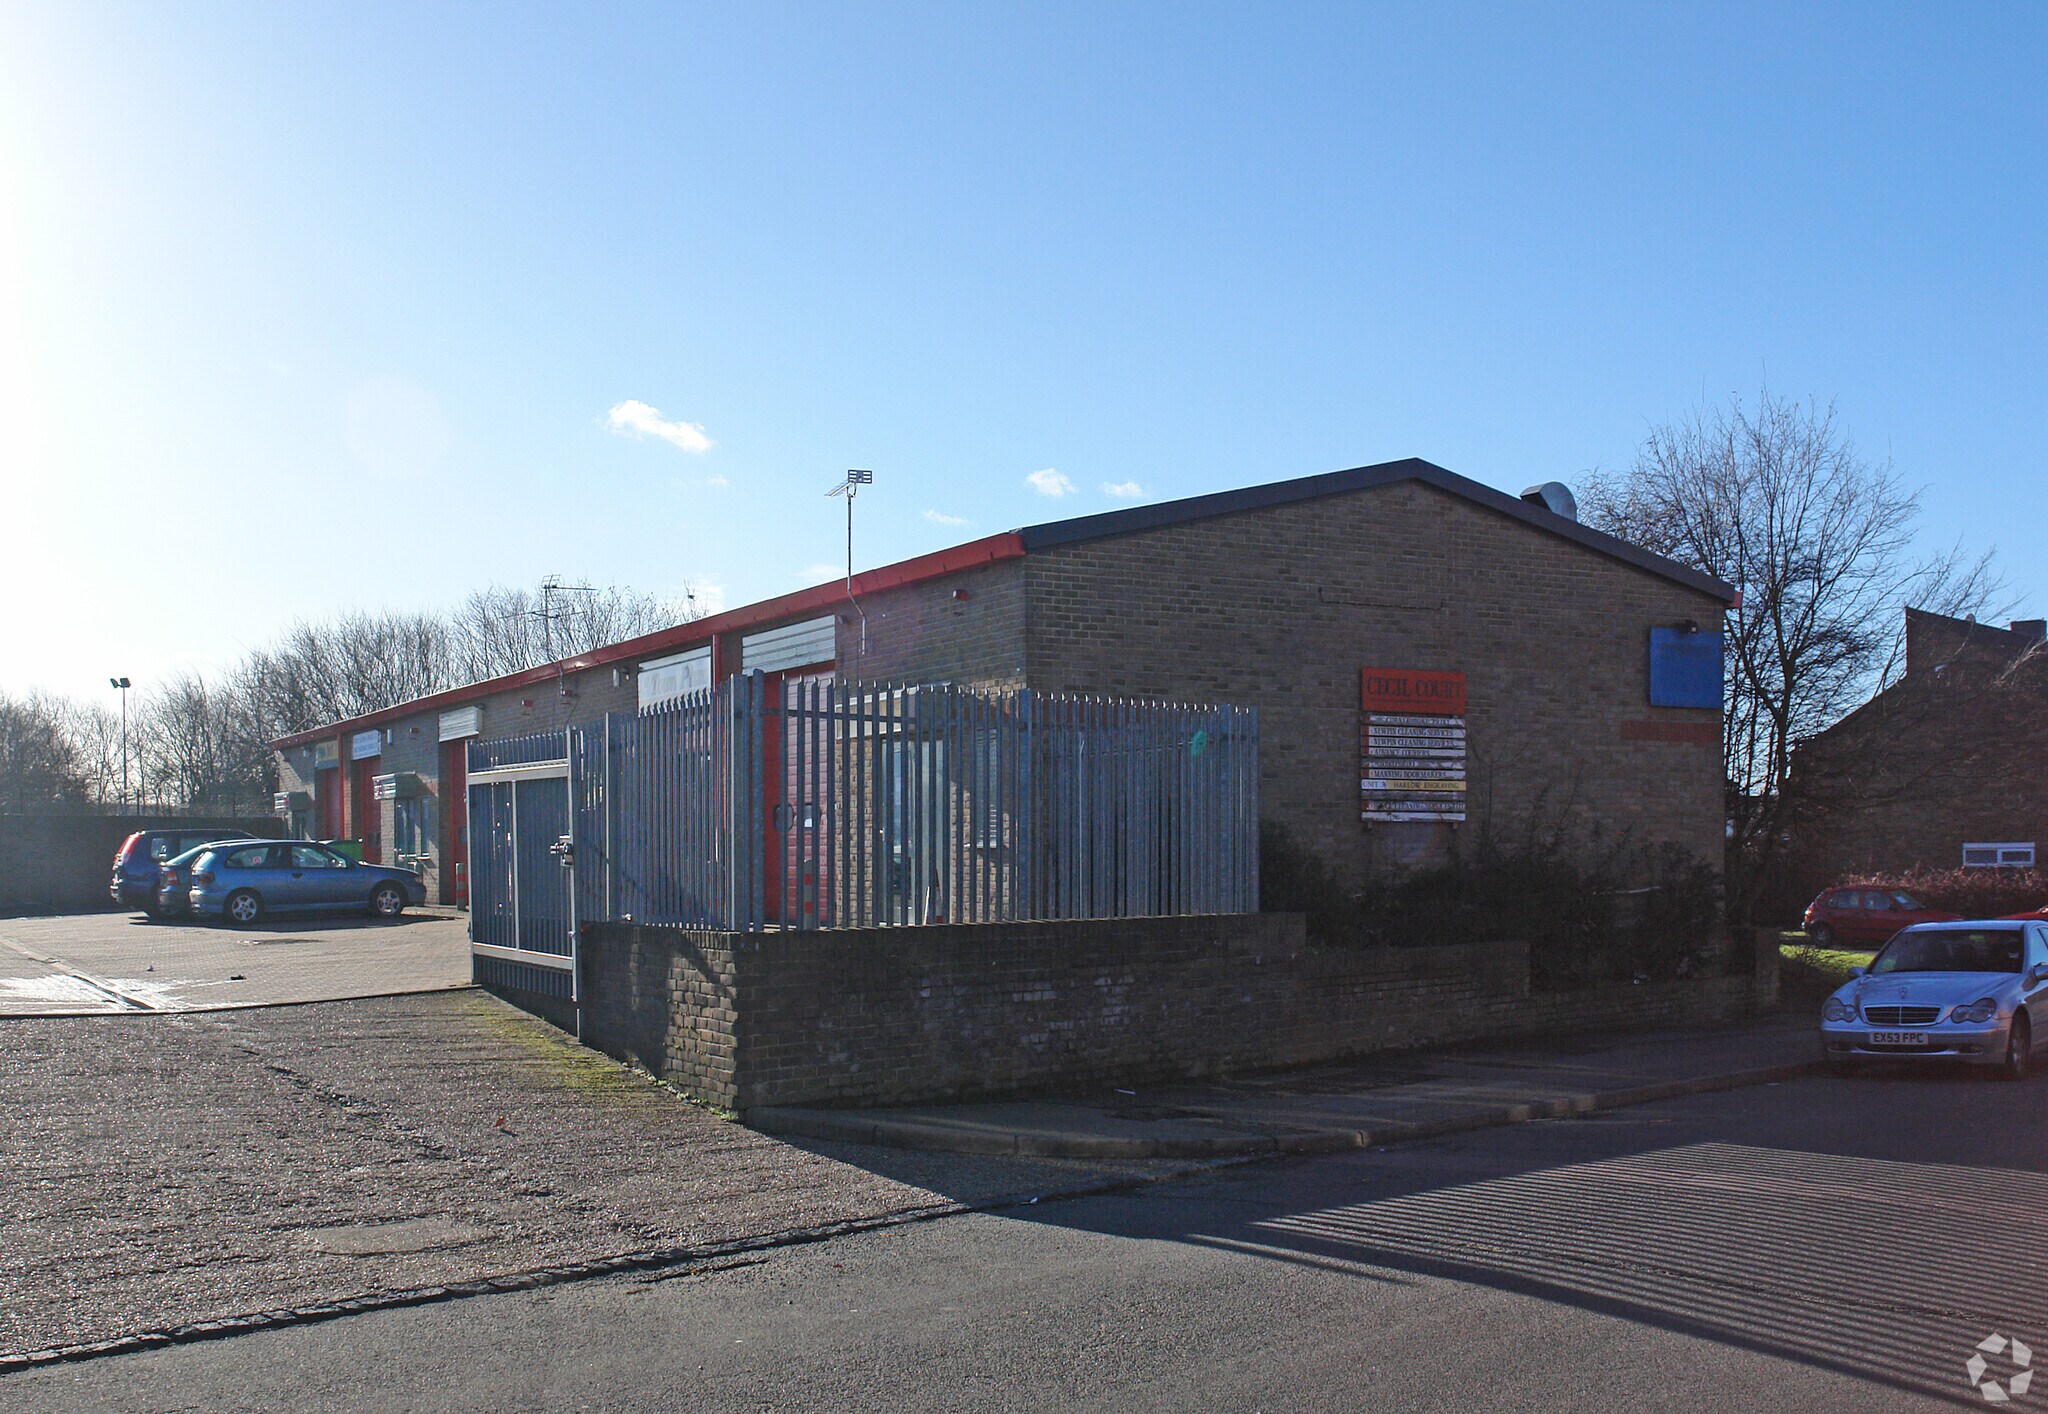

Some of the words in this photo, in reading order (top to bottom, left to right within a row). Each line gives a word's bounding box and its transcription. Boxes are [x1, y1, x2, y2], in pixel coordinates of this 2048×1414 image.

[1366, 677, 1411, 697] CECIL
[1414, 679, 1461, 698] COURT
[1373, 727, 1396, 735] NEWPIN
[1397, 728, 1427, 736] CLEANING
[1427, 729, 1454, 737] SERVICES
[1397, 738, 1427, 746] CLEANING
[1374, 770, 1403, 778] MANNING
[1362, 780, 1378, 788] UNIT
[1393, 781, 1420, 789] HARLOW
[1424, 781, 1459, 789] ENGRAVING
[1873, 1032, 1900, 1043] EX53
[1902, 1032, 1924, 1043] FPC
